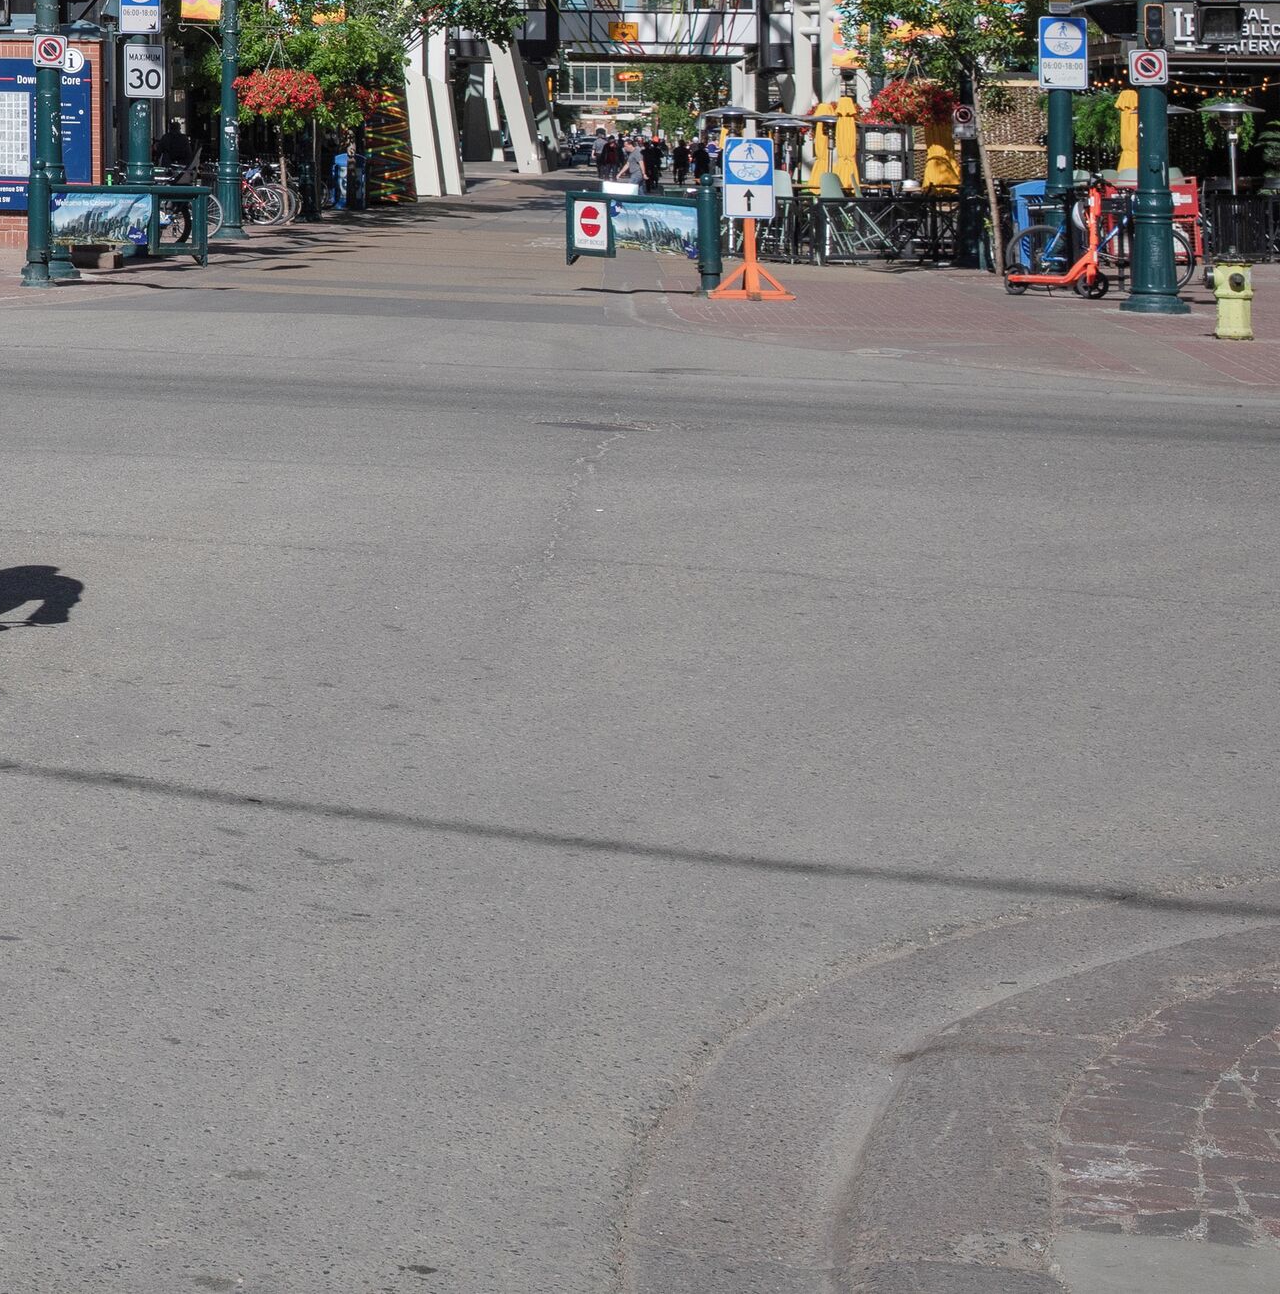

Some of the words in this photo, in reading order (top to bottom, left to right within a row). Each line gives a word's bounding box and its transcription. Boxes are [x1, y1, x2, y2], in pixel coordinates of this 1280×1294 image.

[123, 8, 158, 17] 06:00-18:00
[128, 53, 161, 62] MAXIMUM
[1042, 61, 1084, 71] 06:00-18:00
[61, 75, 81, 85] Core
[128, 68, 162, 90] 30
